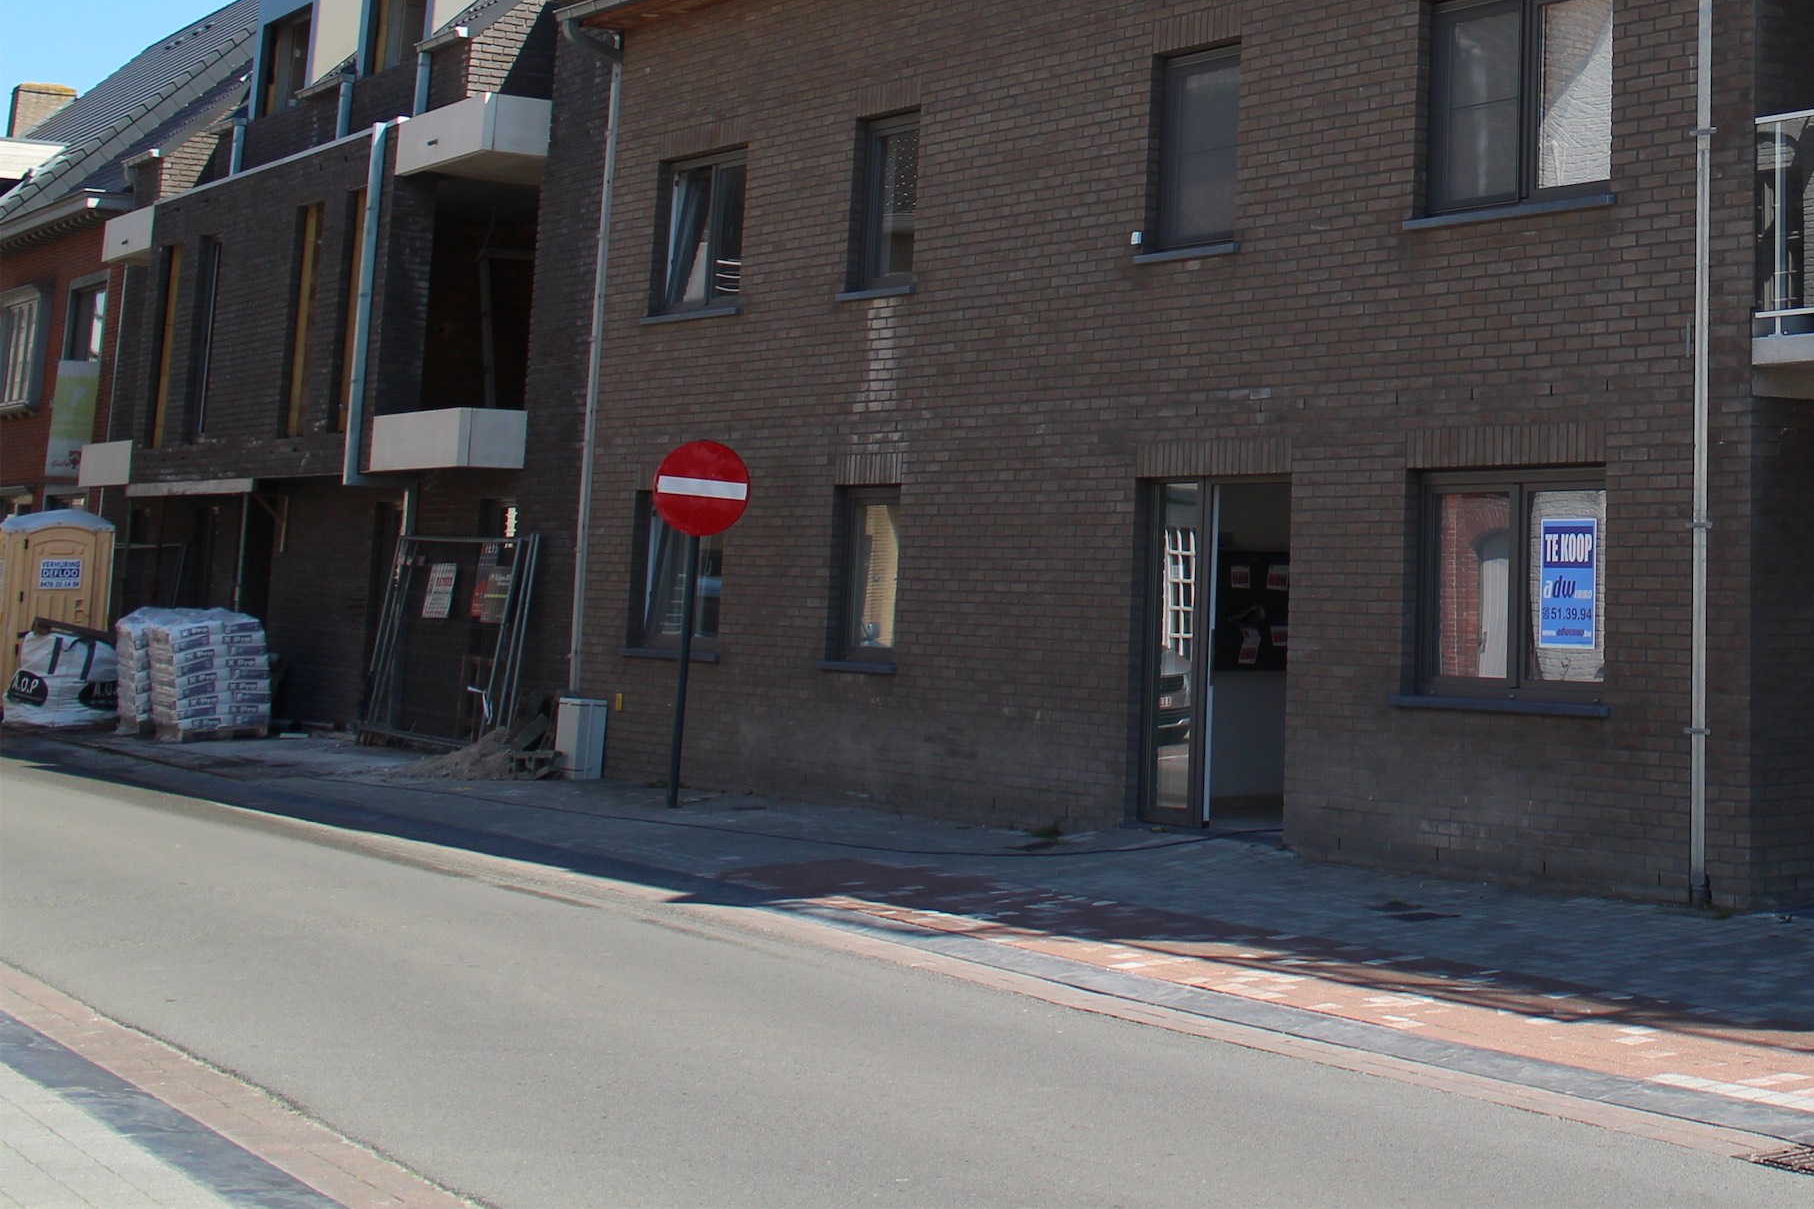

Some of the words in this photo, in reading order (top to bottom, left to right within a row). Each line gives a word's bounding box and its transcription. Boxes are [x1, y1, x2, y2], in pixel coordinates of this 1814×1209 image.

[1545, 533, 1559, 562] TE
[1560, 533, 1593, 563] KOOP
[42, 560, 80, 568] VERHURING
[42, 569, 79, 578] DEFLOO
[1551, 607, 1592, 620] 51.39.94
[237, 659, 255, 667] Pro
[239, 682, 257, 690] Pro
